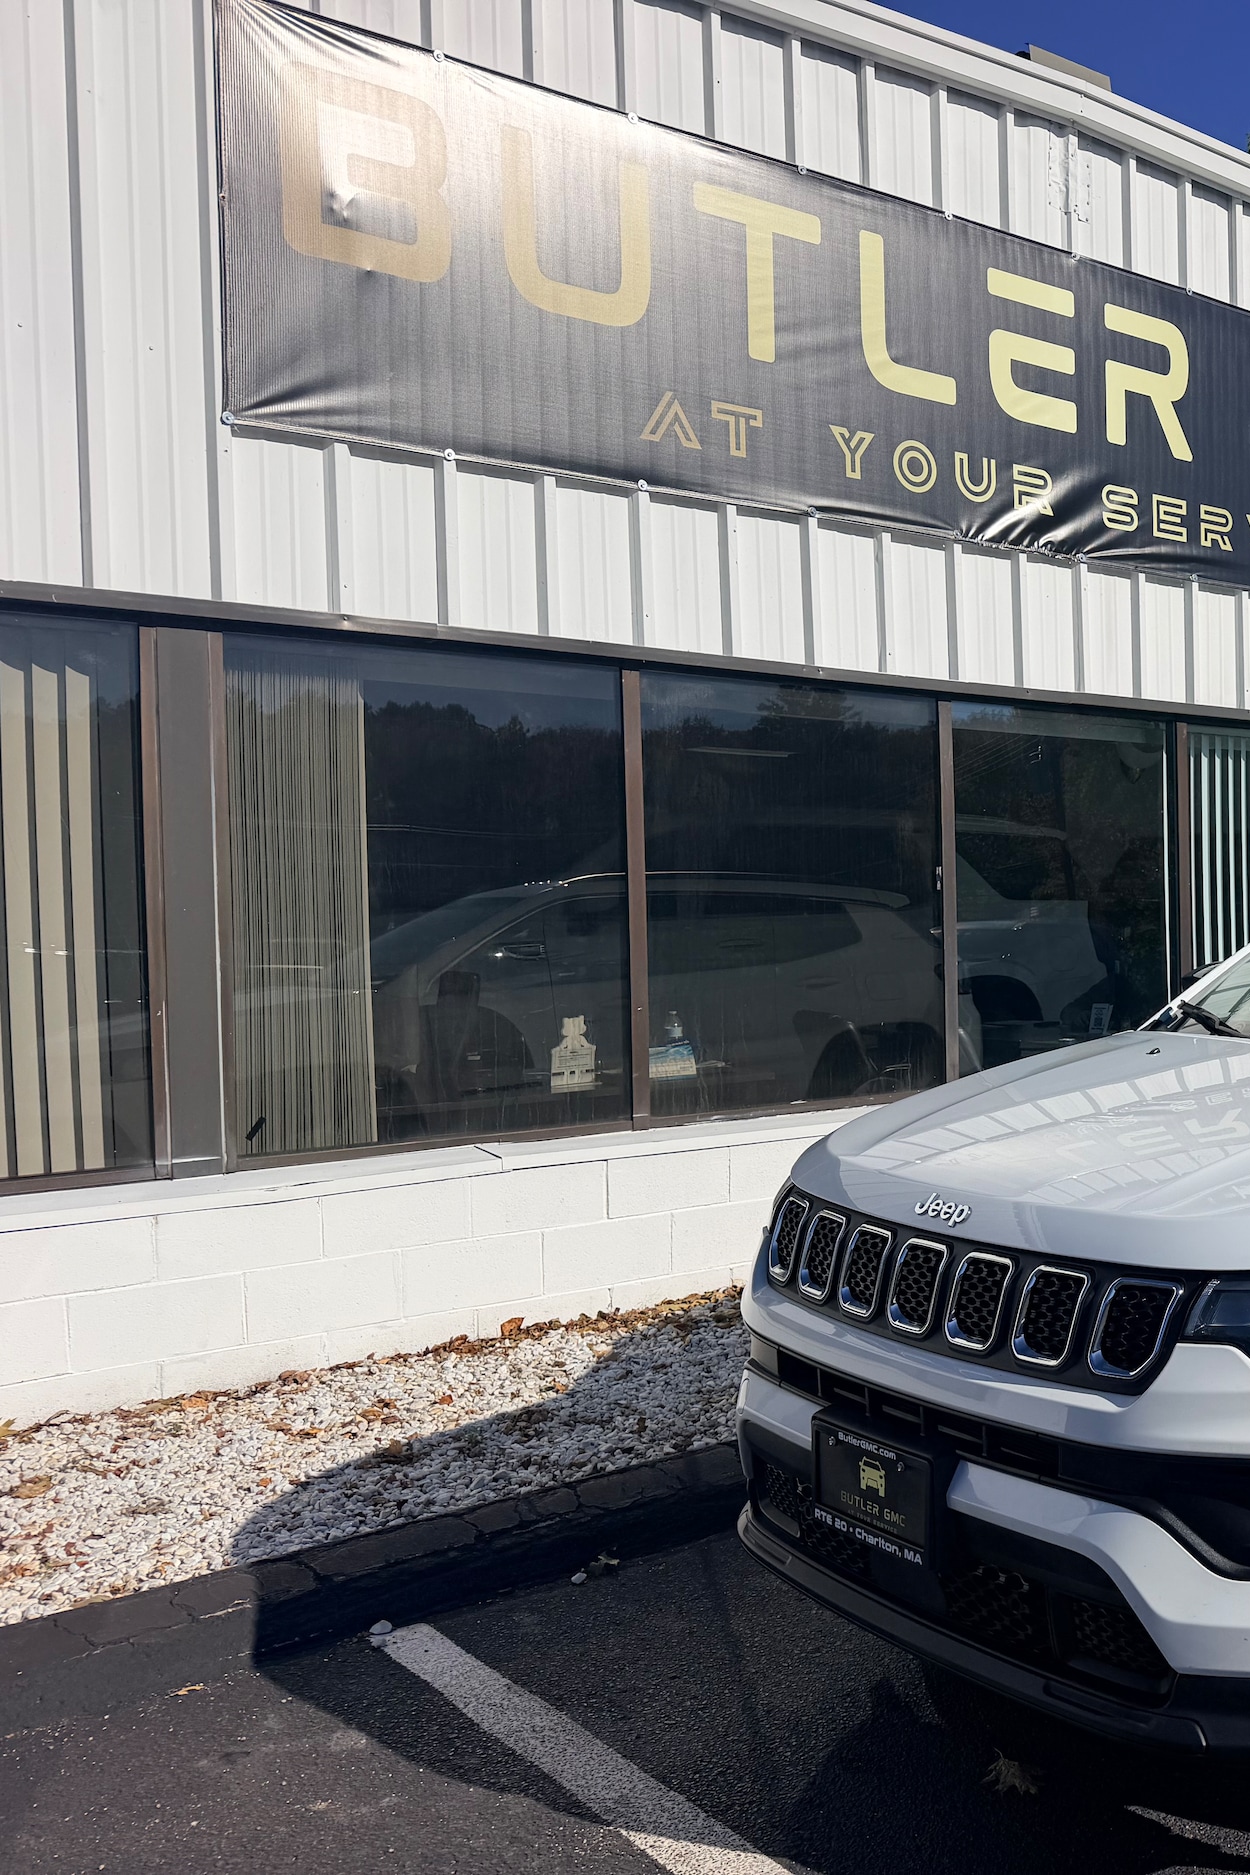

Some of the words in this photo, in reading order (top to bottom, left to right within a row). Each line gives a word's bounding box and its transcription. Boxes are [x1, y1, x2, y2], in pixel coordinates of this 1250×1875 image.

[281, 59, 1193, 462] BUTLER
[640, 390, 763, 457] AT
[827, 424, 1054, 516] YOUR
[914, 1193, 972, 1228] Jeep
[838, 1431, 897, 1461] ButlerGMC.com
[840, 1490, 880, 1517] BUTLER
[883, 1508, 906, 1528] GMC
[814, 1508, 832, 1526] RTE
[835, 1518, 847, 1532] 20
[855, 1528, 901, 1558] Charlton,
[904, 1549, 923, 1566] MA
